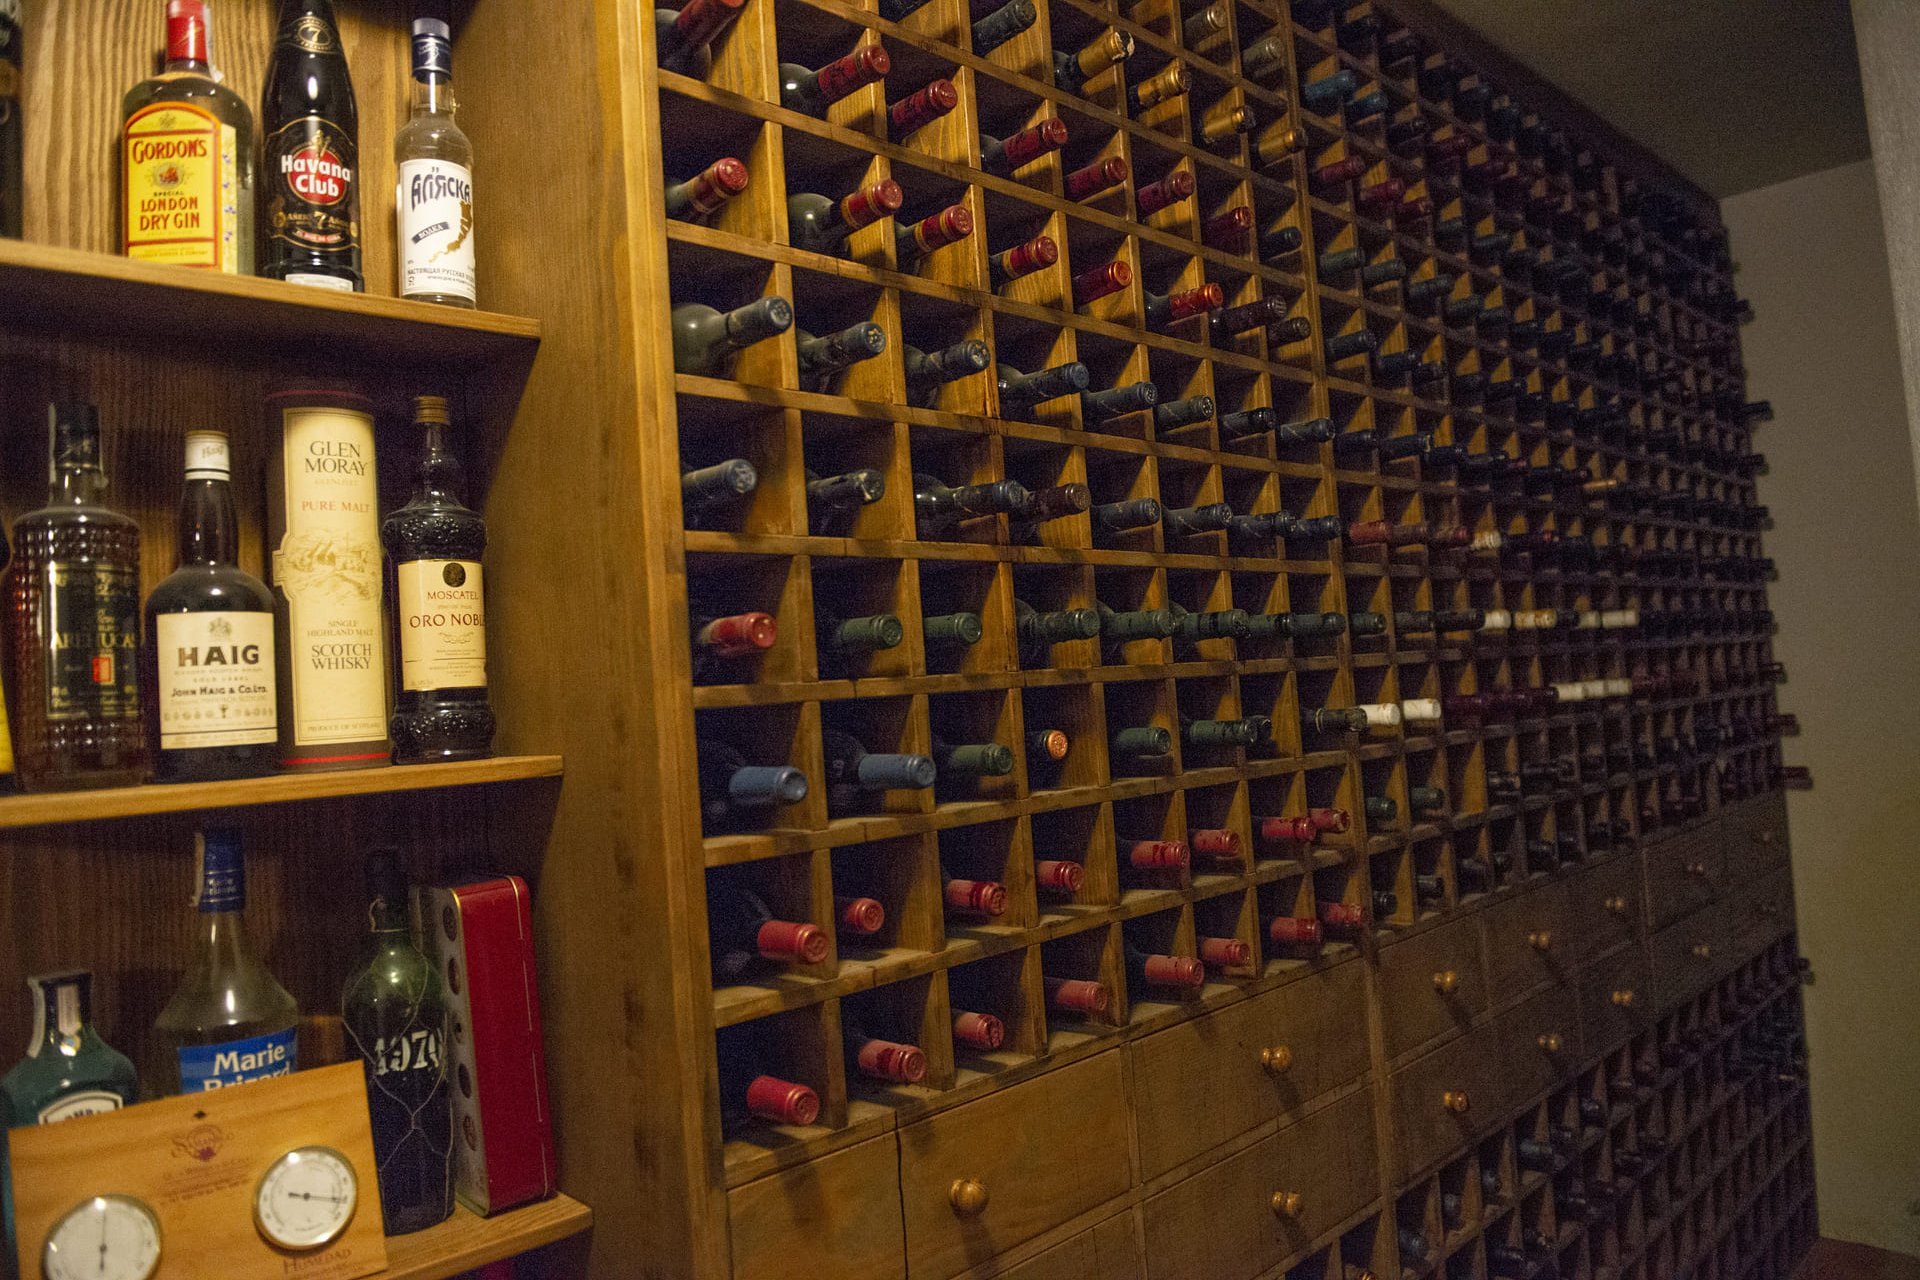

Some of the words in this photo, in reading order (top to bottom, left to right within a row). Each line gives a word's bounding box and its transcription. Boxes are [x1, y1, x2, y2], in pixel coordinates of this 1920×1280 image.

[132, 139, 207, 165] GORDON'S
[281, 155, 351, 182] Havana
[295, 175, 339, 197] Club
[141, 196, 198, 212] LONDON
[140, 214, 169, 231] DRY
[173, 212, 200, 229] GIN
[314, 211, 327, 229] 7
[310, 441, 360, 458] GLEN
[304, 458, 367, 476] MORAY
[302, 501, 335, 511] PURE
[341, 502, 369, 513] MALT
[427, 591, 479, 600] MOSCATEL
[409, 614, 445, 628] ORO
[178, 645, 259, 667] HAIG
[311, 643, 371, 657] SCOTCH
[312, 657, 371, 669] WHISKY
[172, 687, 197, 698] JOHN
[199, 686, 226, 695] HAIG
[213, 1043, 286, 1076] Marie
[374, 1030, 443, 1076] 1970
